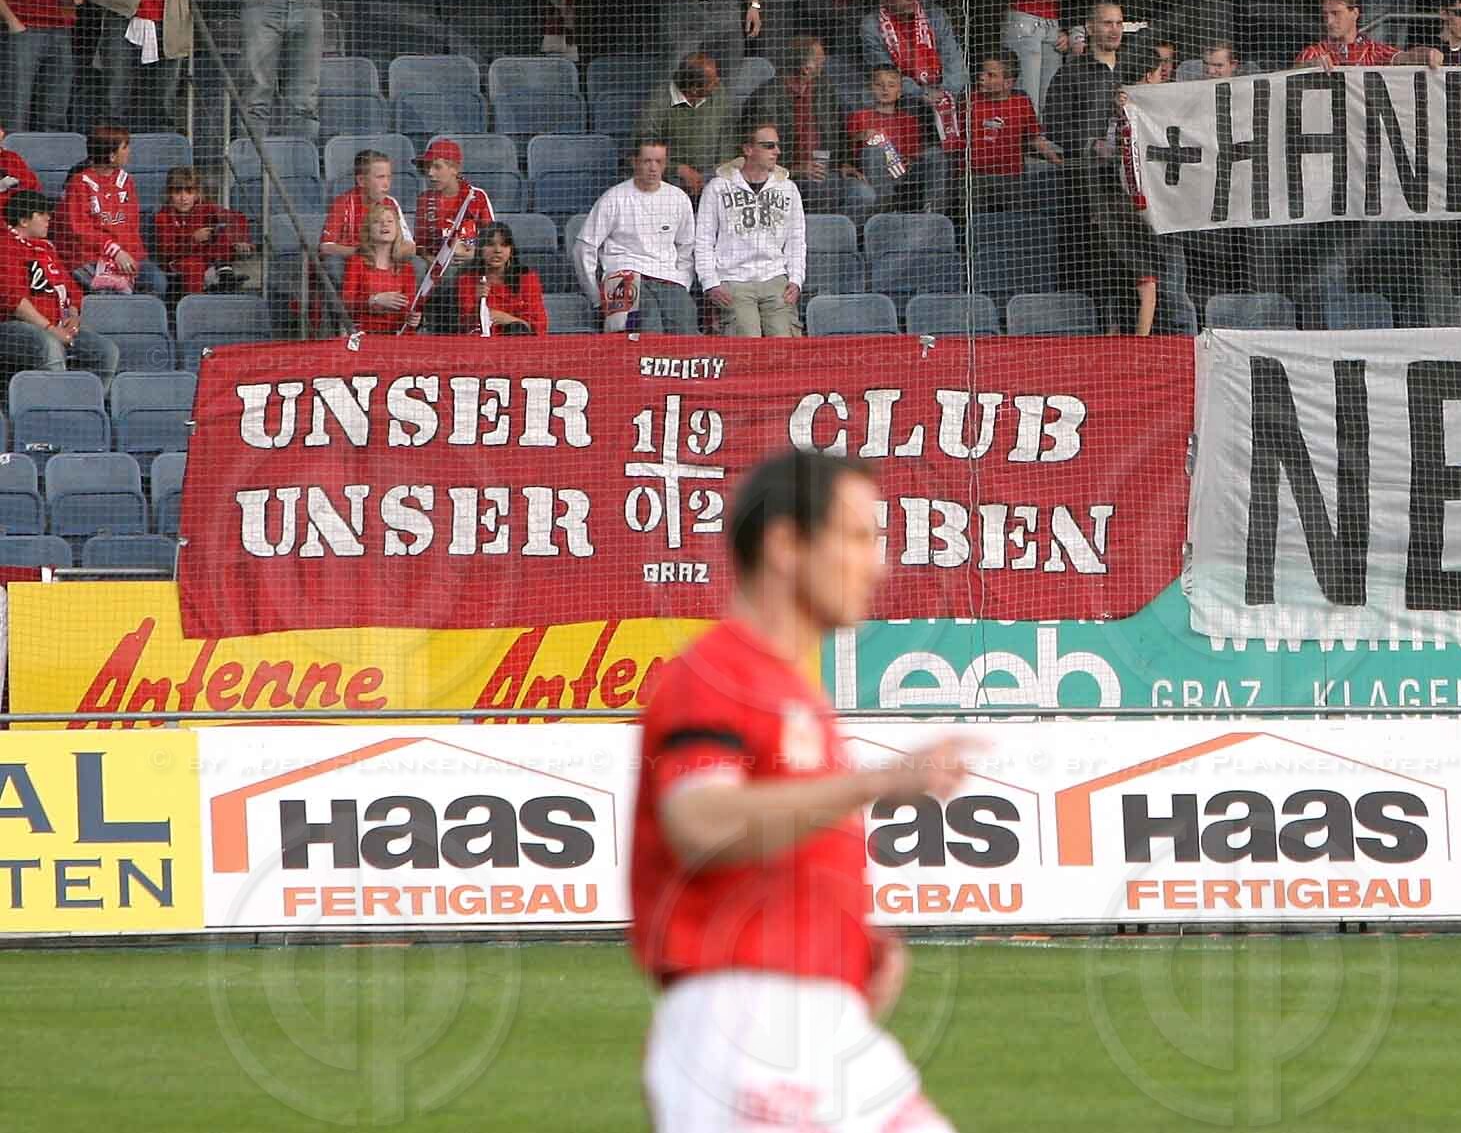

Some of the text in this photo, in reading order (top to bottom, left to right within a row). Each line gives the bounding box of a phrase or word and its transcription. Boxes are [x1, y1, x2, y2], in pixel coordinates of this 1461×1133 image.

[639, 357, 726, 380] SOCIETY
[236, 376, 1089, 464] UNSER CLUB
[236, 484, 1115, 575] UNSER BEN
[642, 563, 711, 584] GRAZ
[72, 617, 390, 731] Antenne
[1151, 679, 1262, 716] GRAZ
[278, 795, 596, 870] Haas
[866, 795, 1021, 868] as
[1122, 790, 1430, 868] Haas
[283, 884, 599, 916] FERTIGBAU
[868, 882, 1024, 914] IGBAU
[1126, 877, 1432, 910] FERTIGBAU
